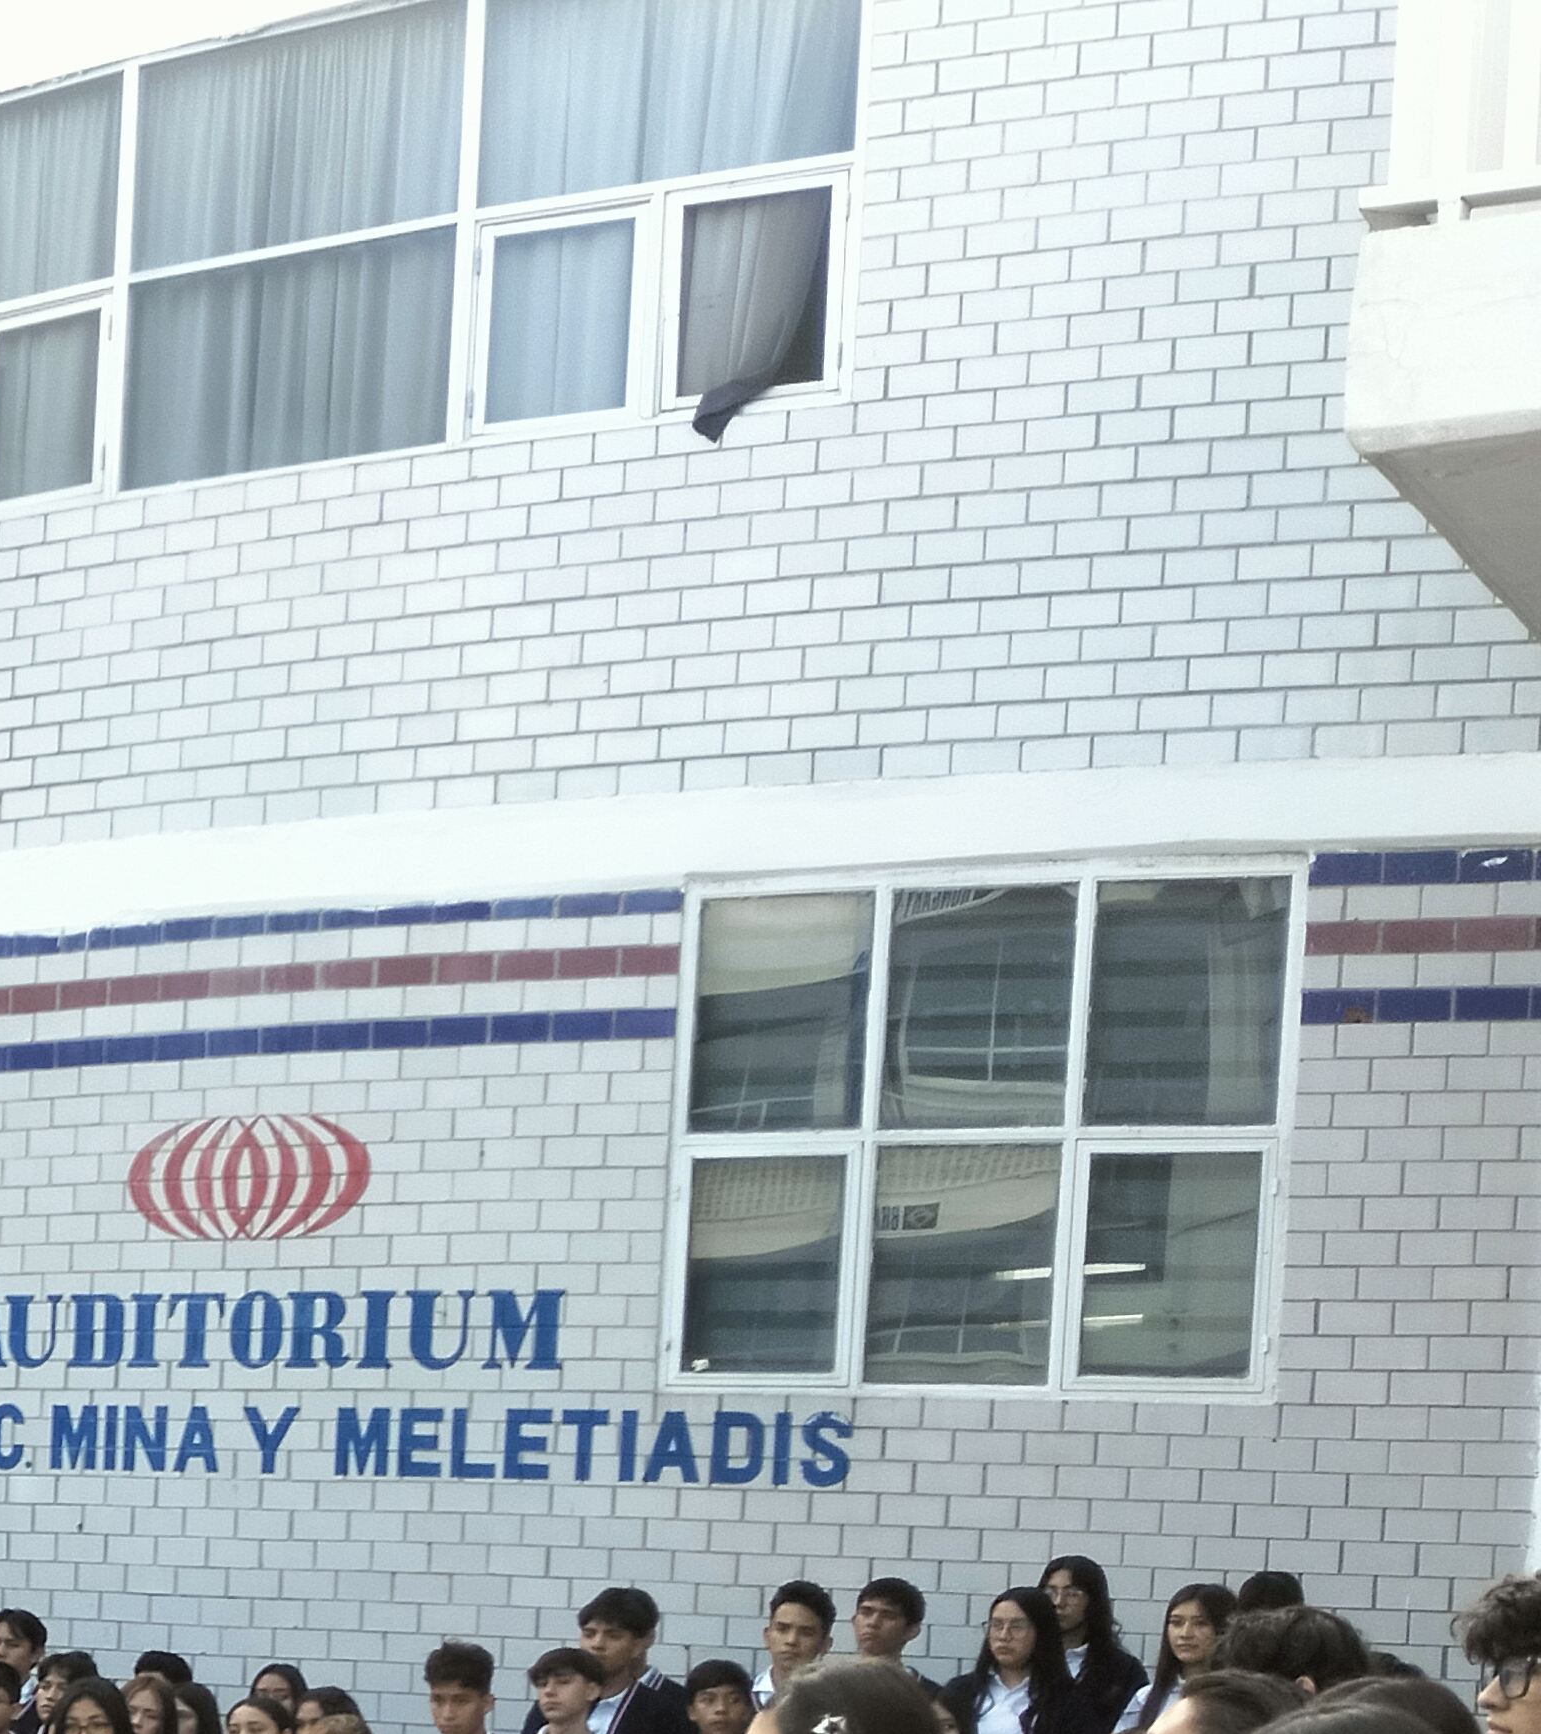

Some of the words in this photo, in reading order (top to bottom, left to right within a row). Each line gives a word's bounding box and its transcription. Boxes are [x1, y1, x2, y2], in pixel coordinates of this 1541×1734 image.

[49, 1404, 219, 1474] MINA
[243, 1406, 300, 1475] Y
[333, 1407, 854, 1488] MELETIADIS
